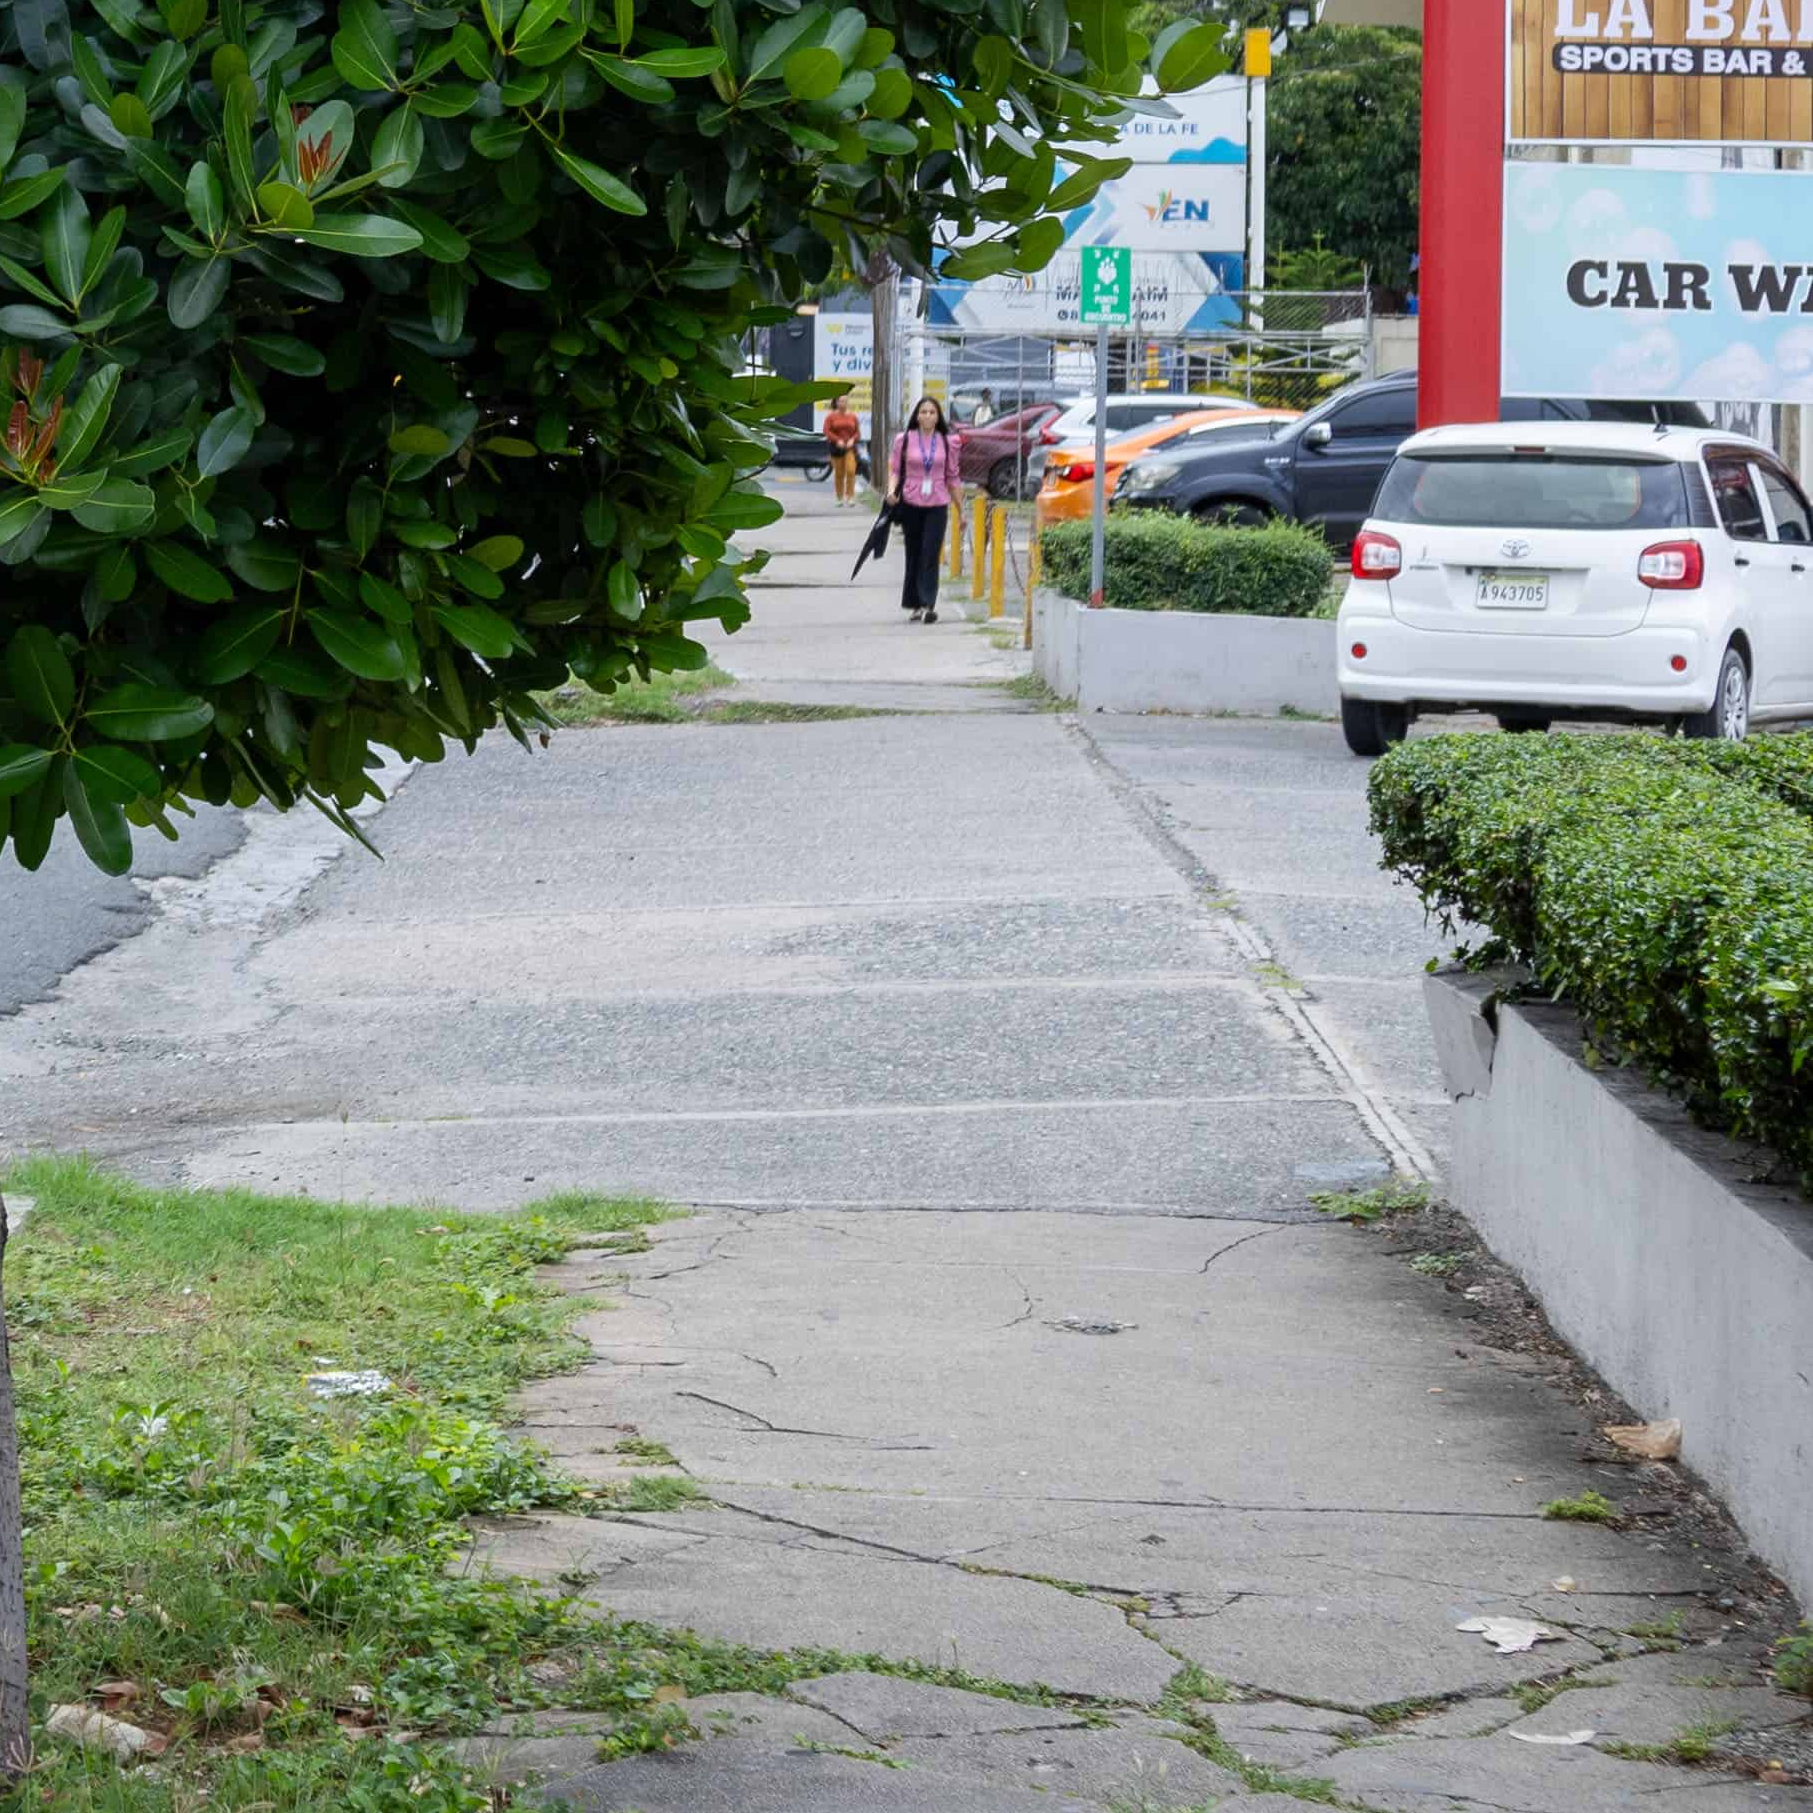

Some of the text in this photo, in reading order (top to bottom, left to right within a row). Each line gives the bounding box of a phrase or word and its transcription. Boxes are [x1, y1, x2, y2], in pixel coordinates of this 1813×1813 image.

[1559, 44, 1806, 76] SPORTS BAR &
[1566, 259, 1813, 314] CAR W
[1480, 587, 1545, 602] A943705
